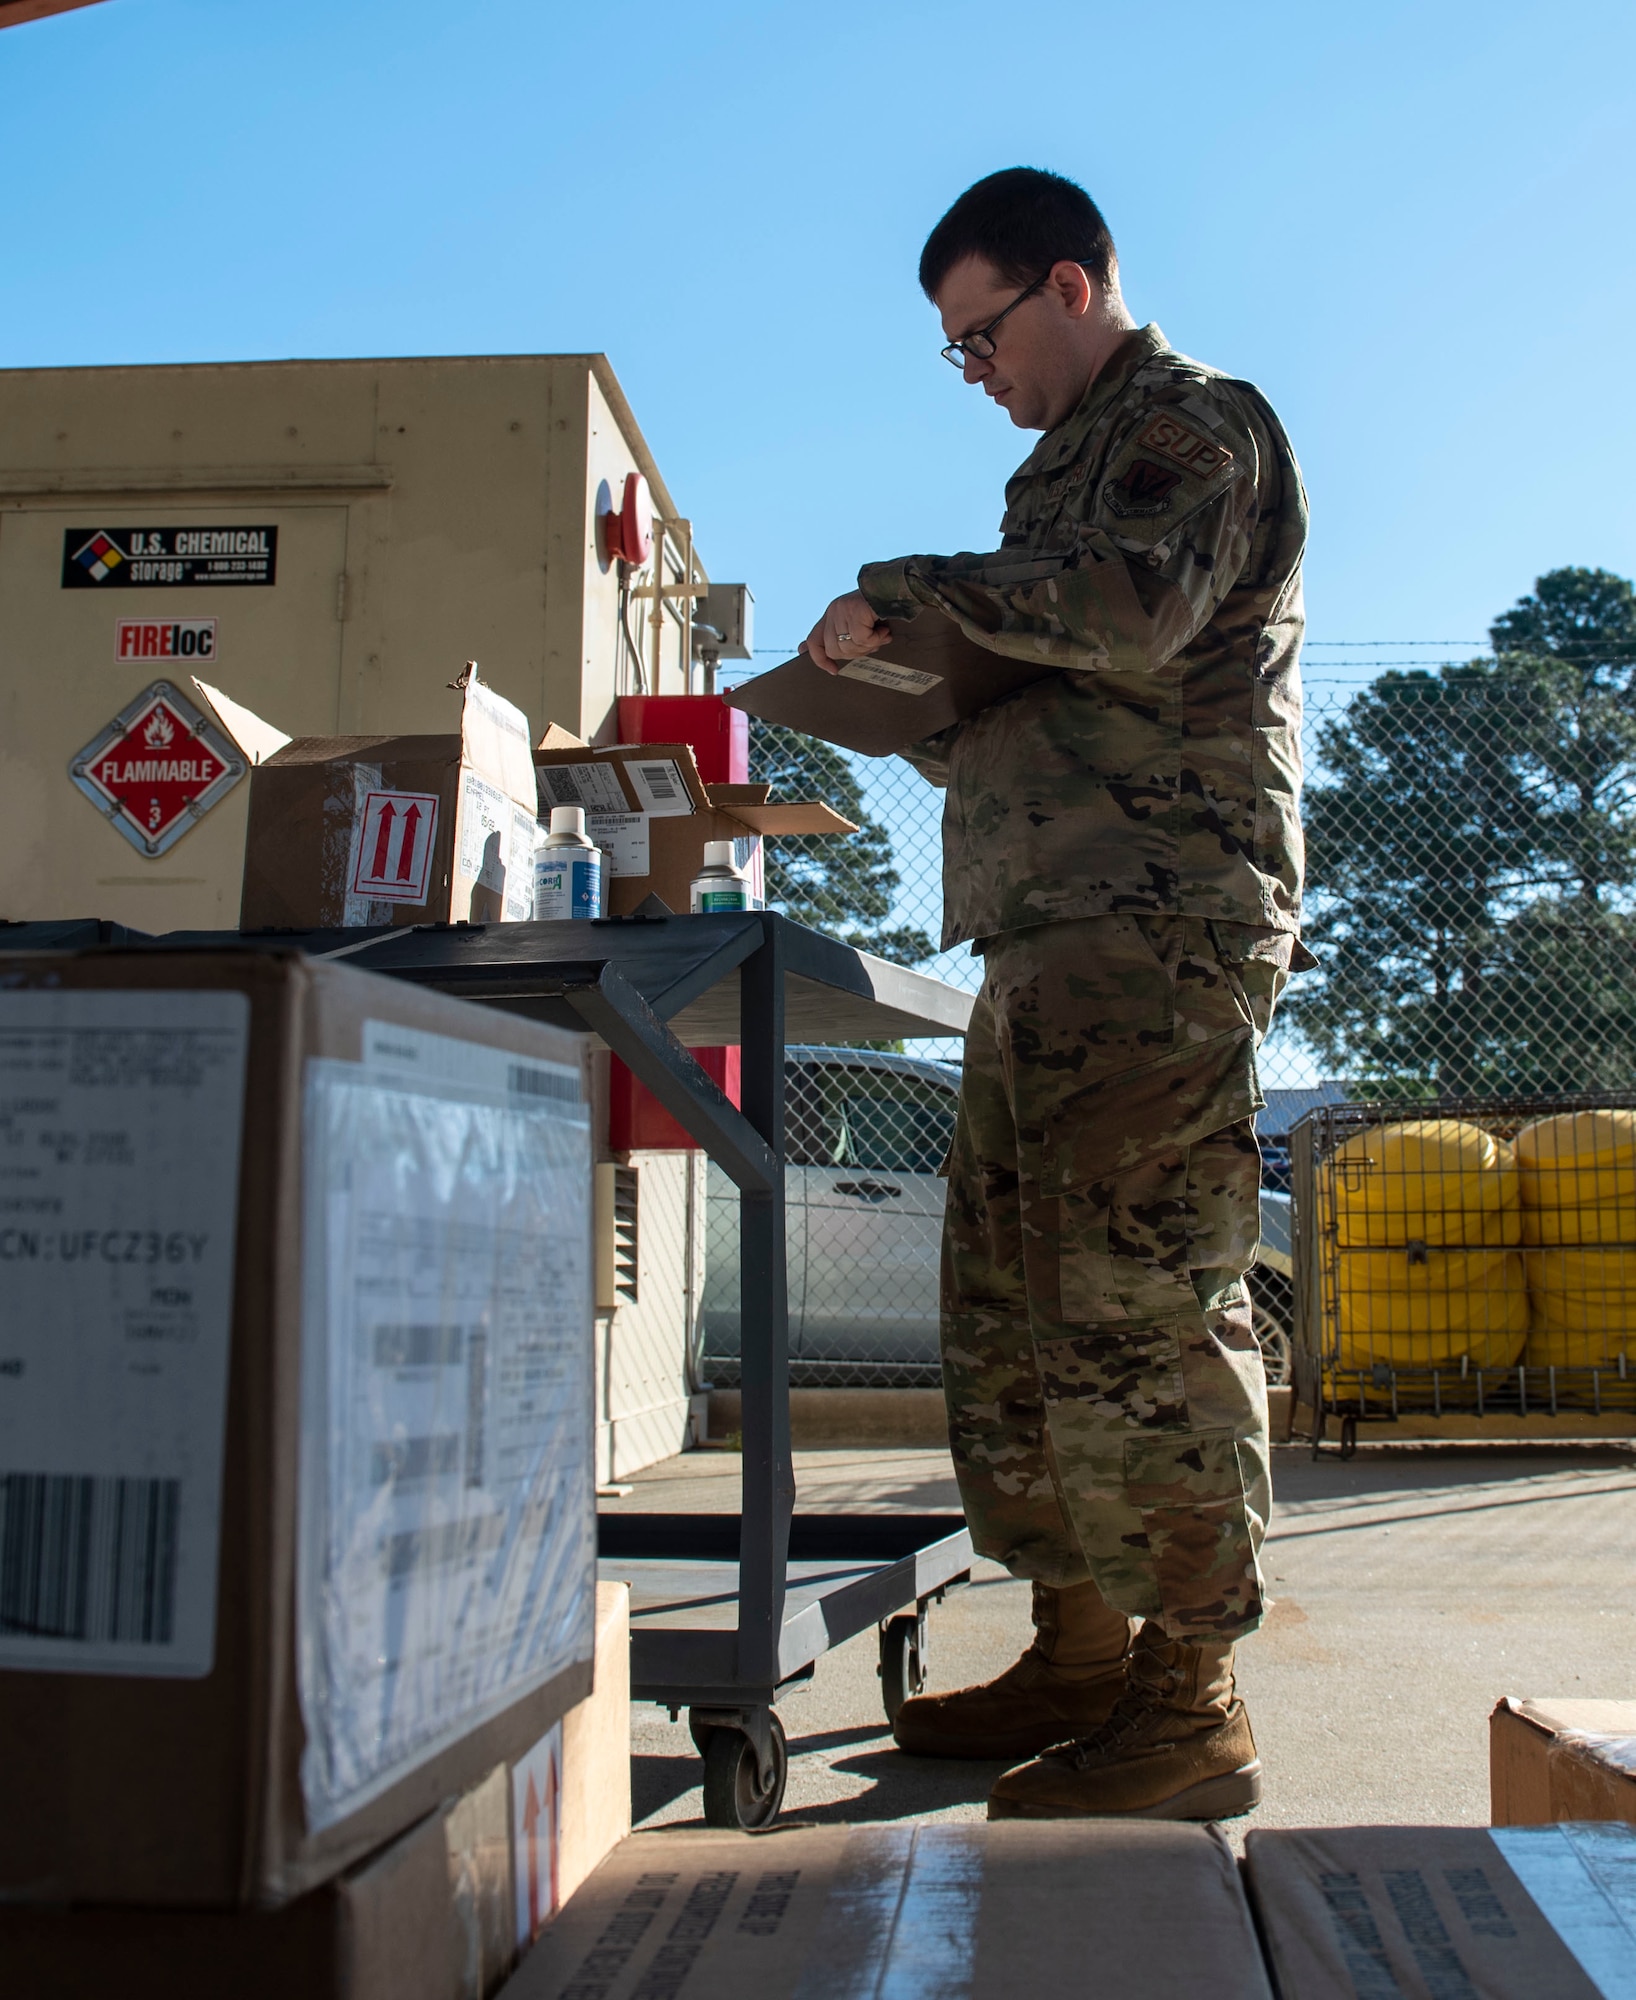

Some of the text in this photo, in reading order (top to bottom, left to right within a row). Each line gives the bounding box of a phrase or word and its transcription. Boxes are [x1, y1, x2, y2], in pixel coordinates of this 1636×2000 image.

[1150, 423, 1219, 466] SUP
[131, 531, 269, 554] U.S. CHEMICAL
[101, 759, 213, 783] FLAMMABLE
[149, 806, 161, 824] 3
